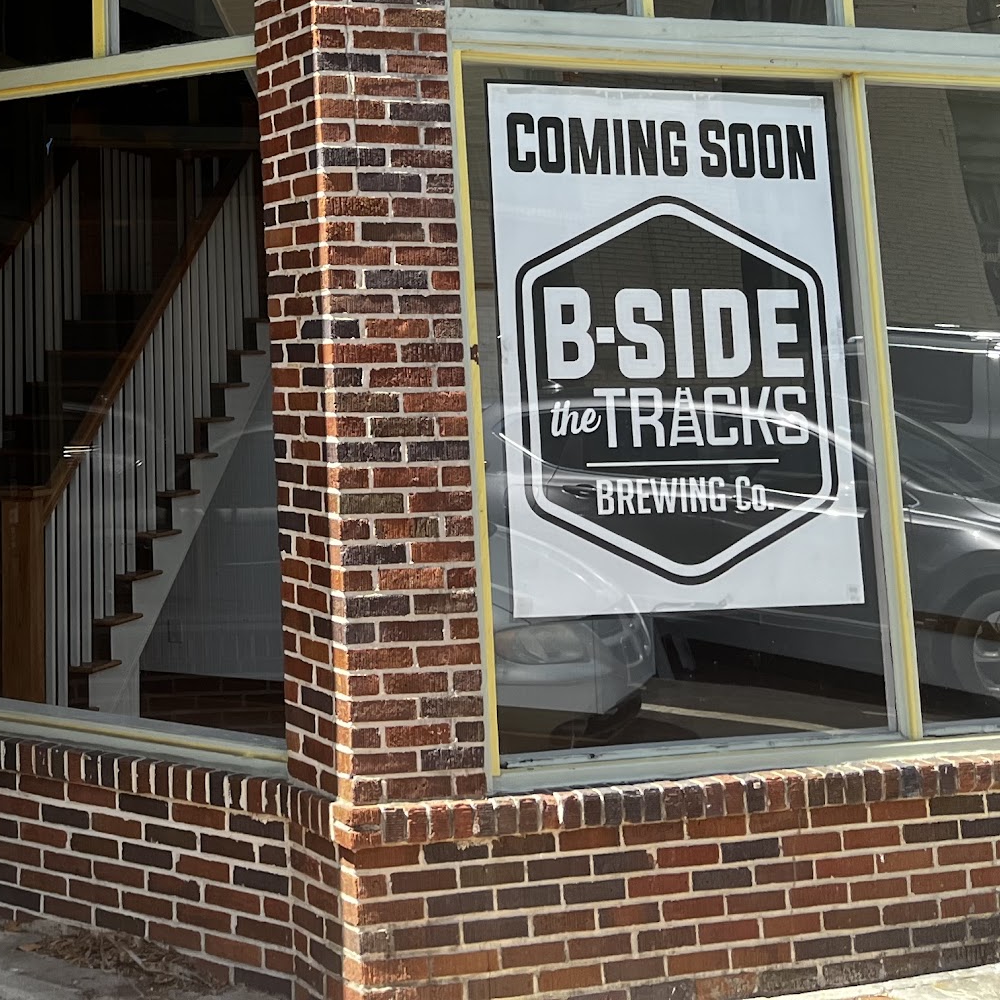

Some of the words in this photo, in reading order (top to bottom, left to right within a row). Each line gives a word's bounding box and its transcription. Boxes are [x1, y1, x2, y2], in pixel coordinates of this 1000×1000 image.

[506, 112, 688, 177] COMING
[698, 119, 817, 181] SOON
[543, 286, 805, 380] B-SIDE
[550, 399, 602, 437] the
[593, 386, 810, 448] TRACKS
[596, 477, 728, 516] BREWING
[735, 475, 775, 512] Co.
